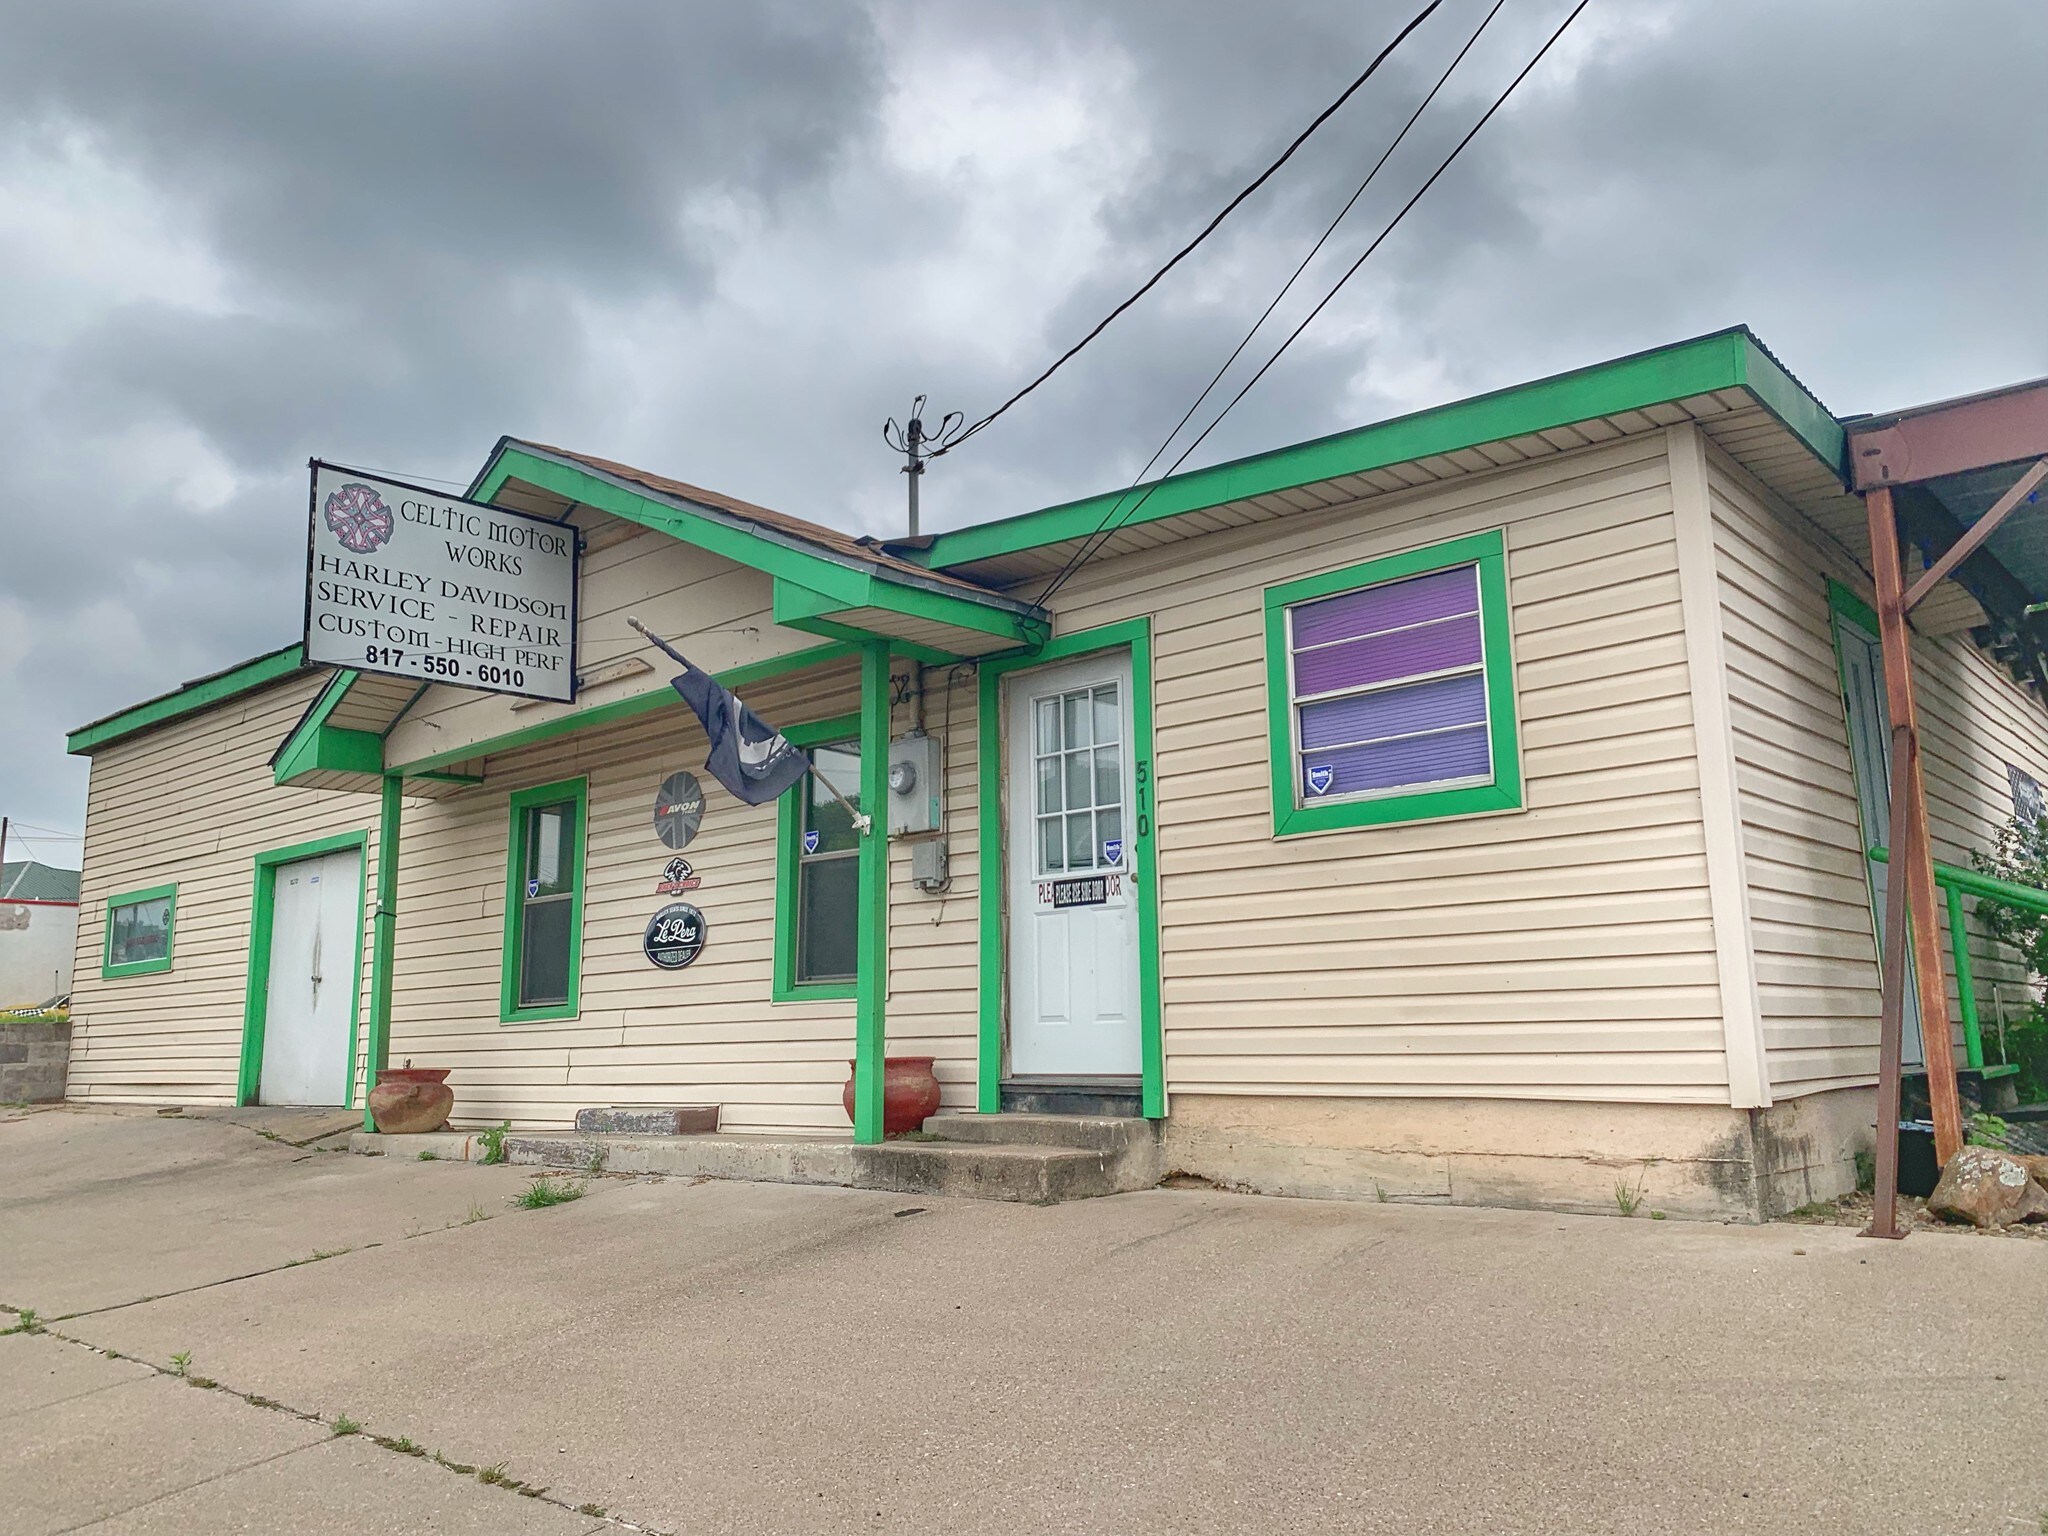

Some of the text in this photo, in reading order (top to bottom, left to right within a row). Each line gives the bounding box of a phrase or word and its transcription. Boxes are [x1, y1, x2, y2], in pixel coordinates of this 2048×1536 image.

[400, 500, 567, 557] CELTIC MOTOR
[445, 541, 522, 576] WORKS
[319, 553, 567, 620] HARLEY DAVIDSON
[317, 581, 435, 621] SERVICE
[470, 613, 561, 647] REPAIR
[515, 649, 563, 671] PERF
[667, 800, 700, 814] AVON
[653, 919, 696, 943] Le Pera
